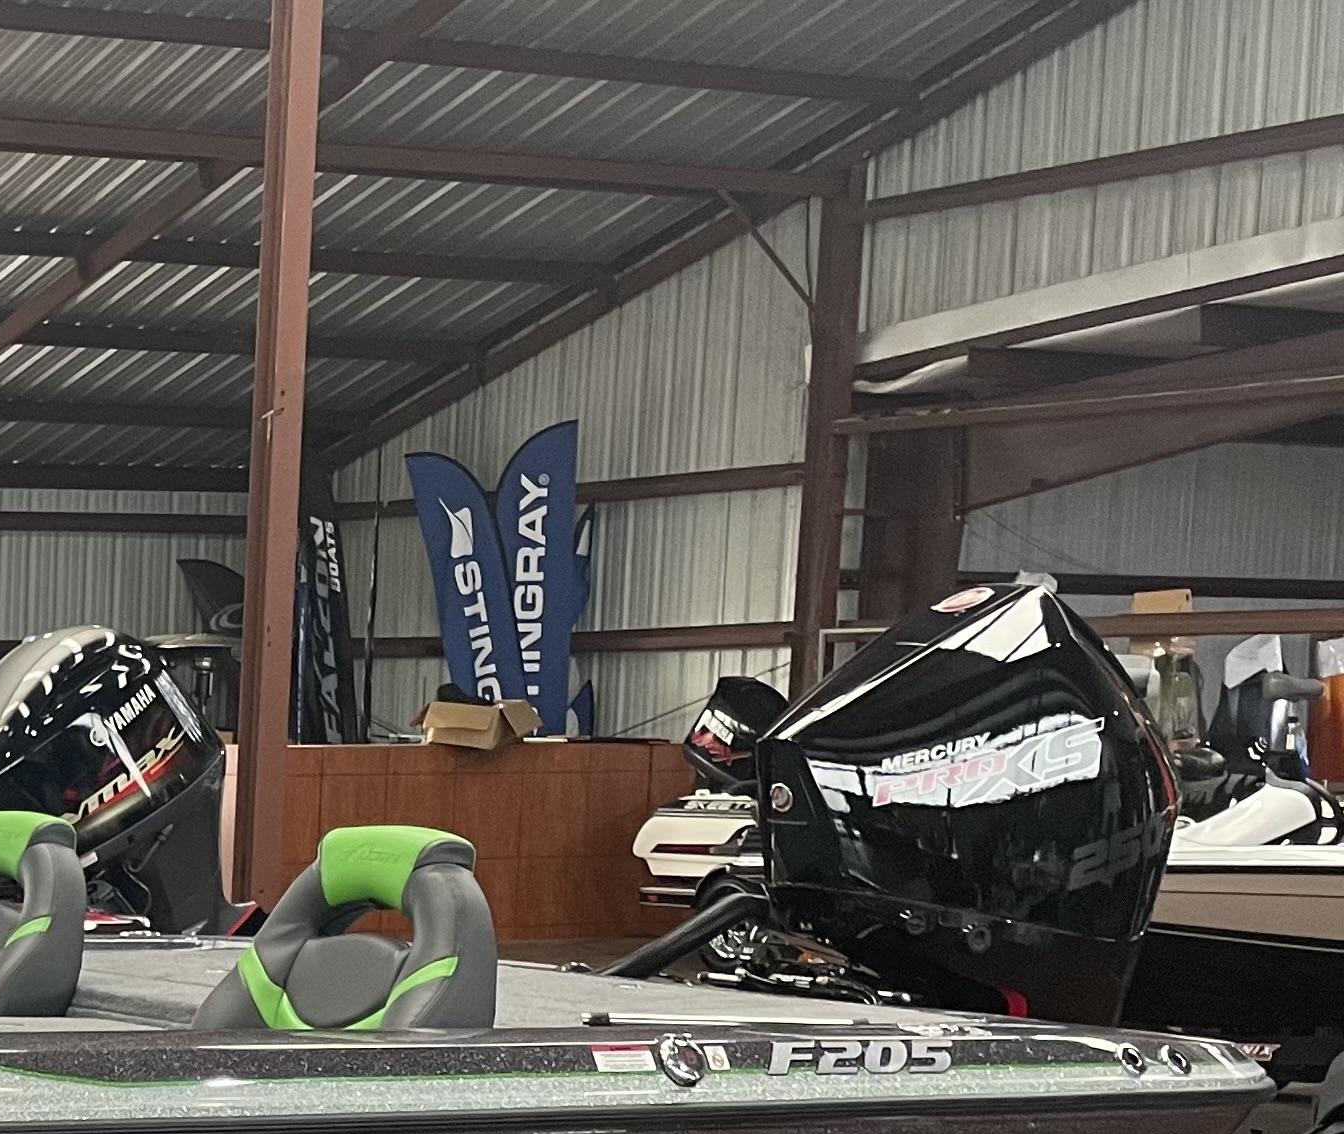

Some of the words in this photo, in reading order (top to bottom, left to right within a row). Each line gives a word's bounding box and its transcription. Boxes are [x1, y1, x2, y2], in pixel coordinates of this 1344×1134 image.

[103, 683, 157, 731] YAMAHA
[881, 731, 991, 773] MERCURY
[872, 749, 1012, 807] PRO
[766, 1039, 953, 1076] F205
